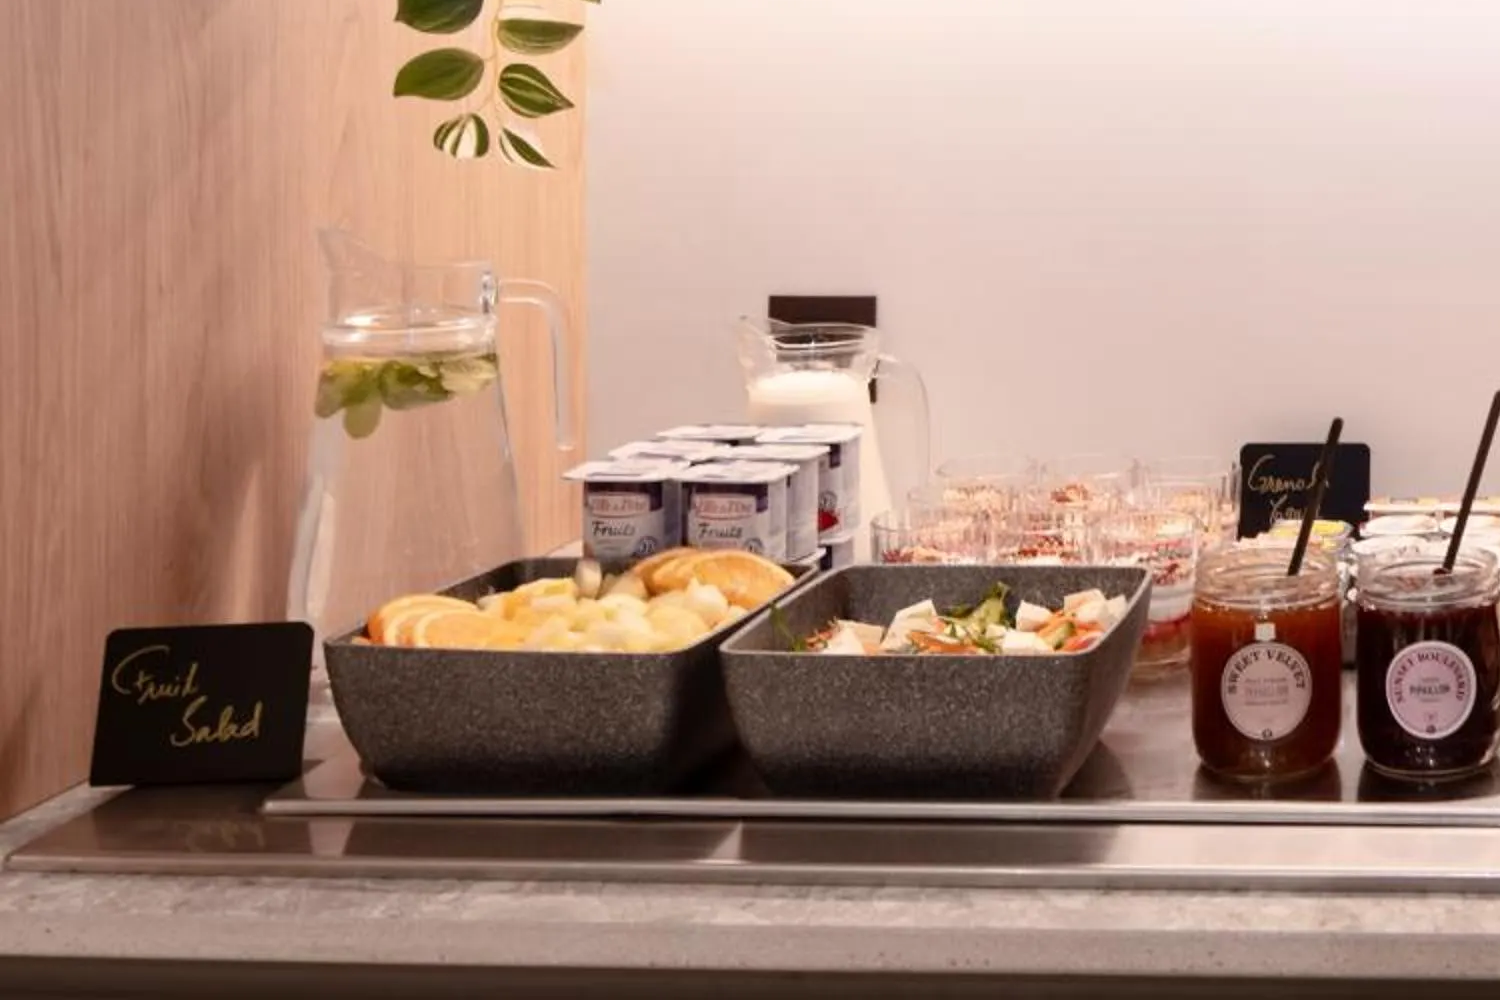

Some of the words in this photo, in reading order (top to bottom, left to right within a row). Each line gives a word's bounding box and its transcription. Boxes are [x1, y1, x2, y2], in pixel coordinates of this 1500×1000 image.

[1248, 453, 1330, 494] Granol
[592, 520, 636, 537] Fruits
[698, 522, 743, 539] Fruits
[112, 645, 199, 706] Fruit
[1227, 649, 1260, 695] SWEET
[1266, 649, 1306, 689] VELVET
[170, 696, 263, 747] Salad
